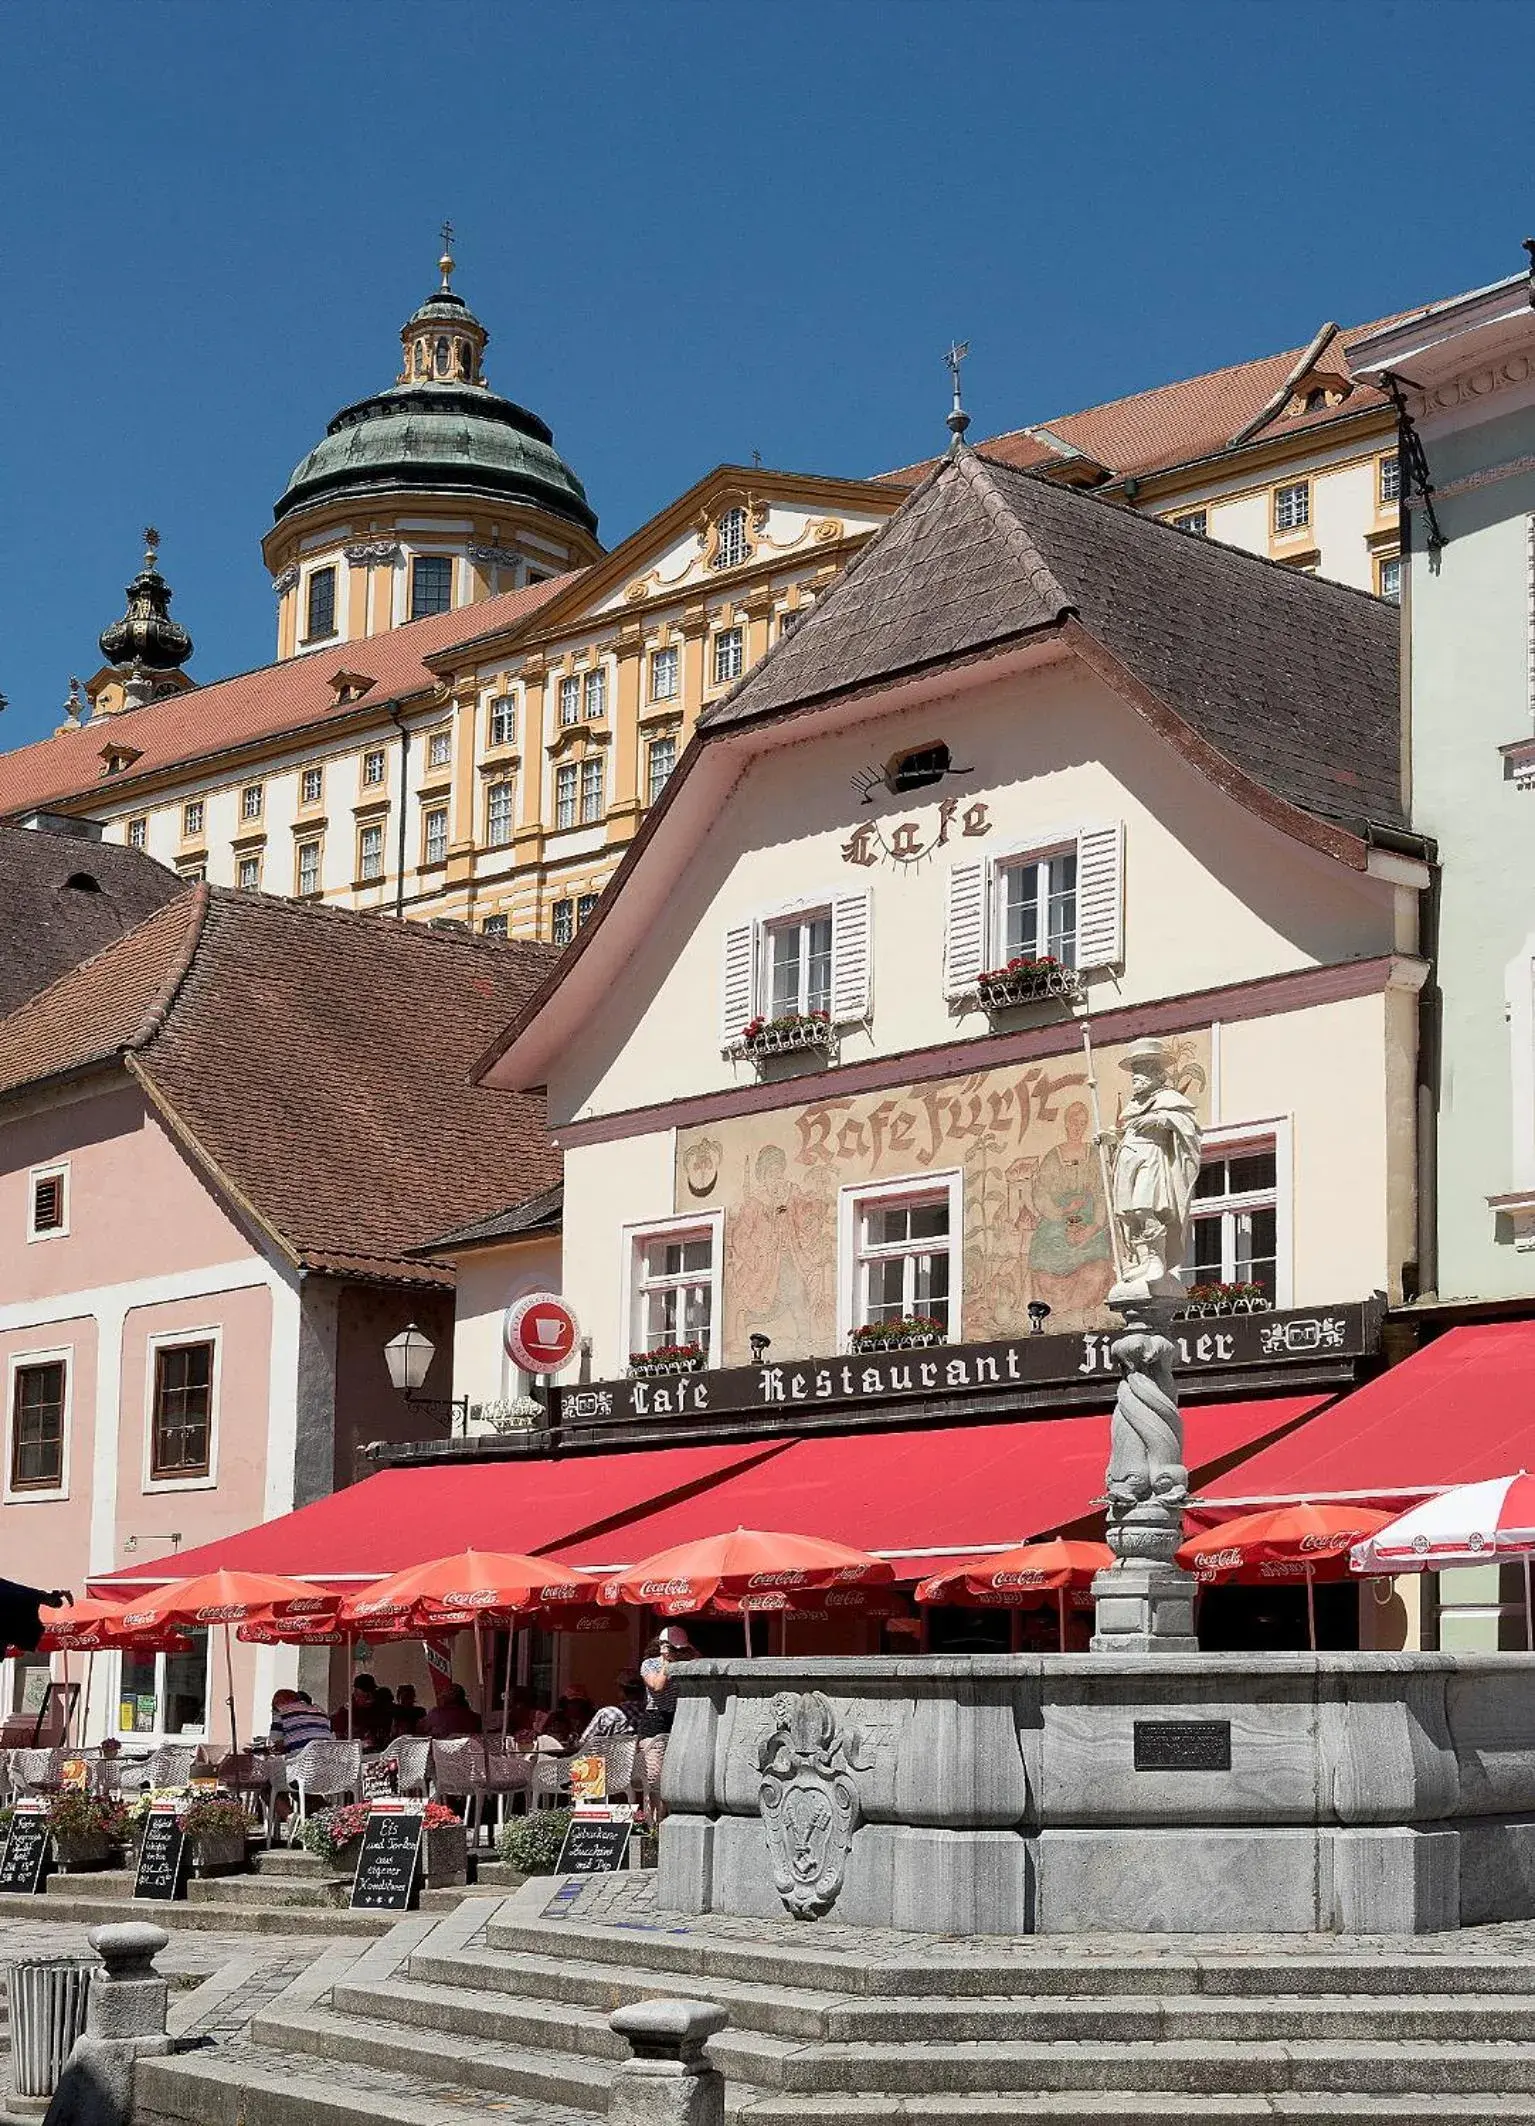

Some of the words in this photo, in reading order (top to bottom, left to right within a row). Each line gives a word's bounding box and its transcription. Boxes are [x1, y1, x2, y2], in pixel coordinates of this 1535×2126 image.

[841, 798, 993, 867] Cafe
[629, 1377, 710, 1414] Cafe
[758, 1348, 1021, 1402] Restaurant
[1078, 1332, 1235, 1374] Zier
[1194, 1549, 1244, 1569] Coca-Cola
[640, 1577, 692, 1598] Coca-Cola
[748, 1568, 809, 1588] Coca-Cola
[992, 1568, 1050, 1588] Coca-Cola
[443, 1589, 499, 1607] Coca-Cola
[540, 1582, 578, 1601] Coca-Cola
[738, 1592, 791, 1610] Coca-Cola
[196, 1603, 248, 1621] Coca-Cola
[380, 1817, 399, 1836] Eis
